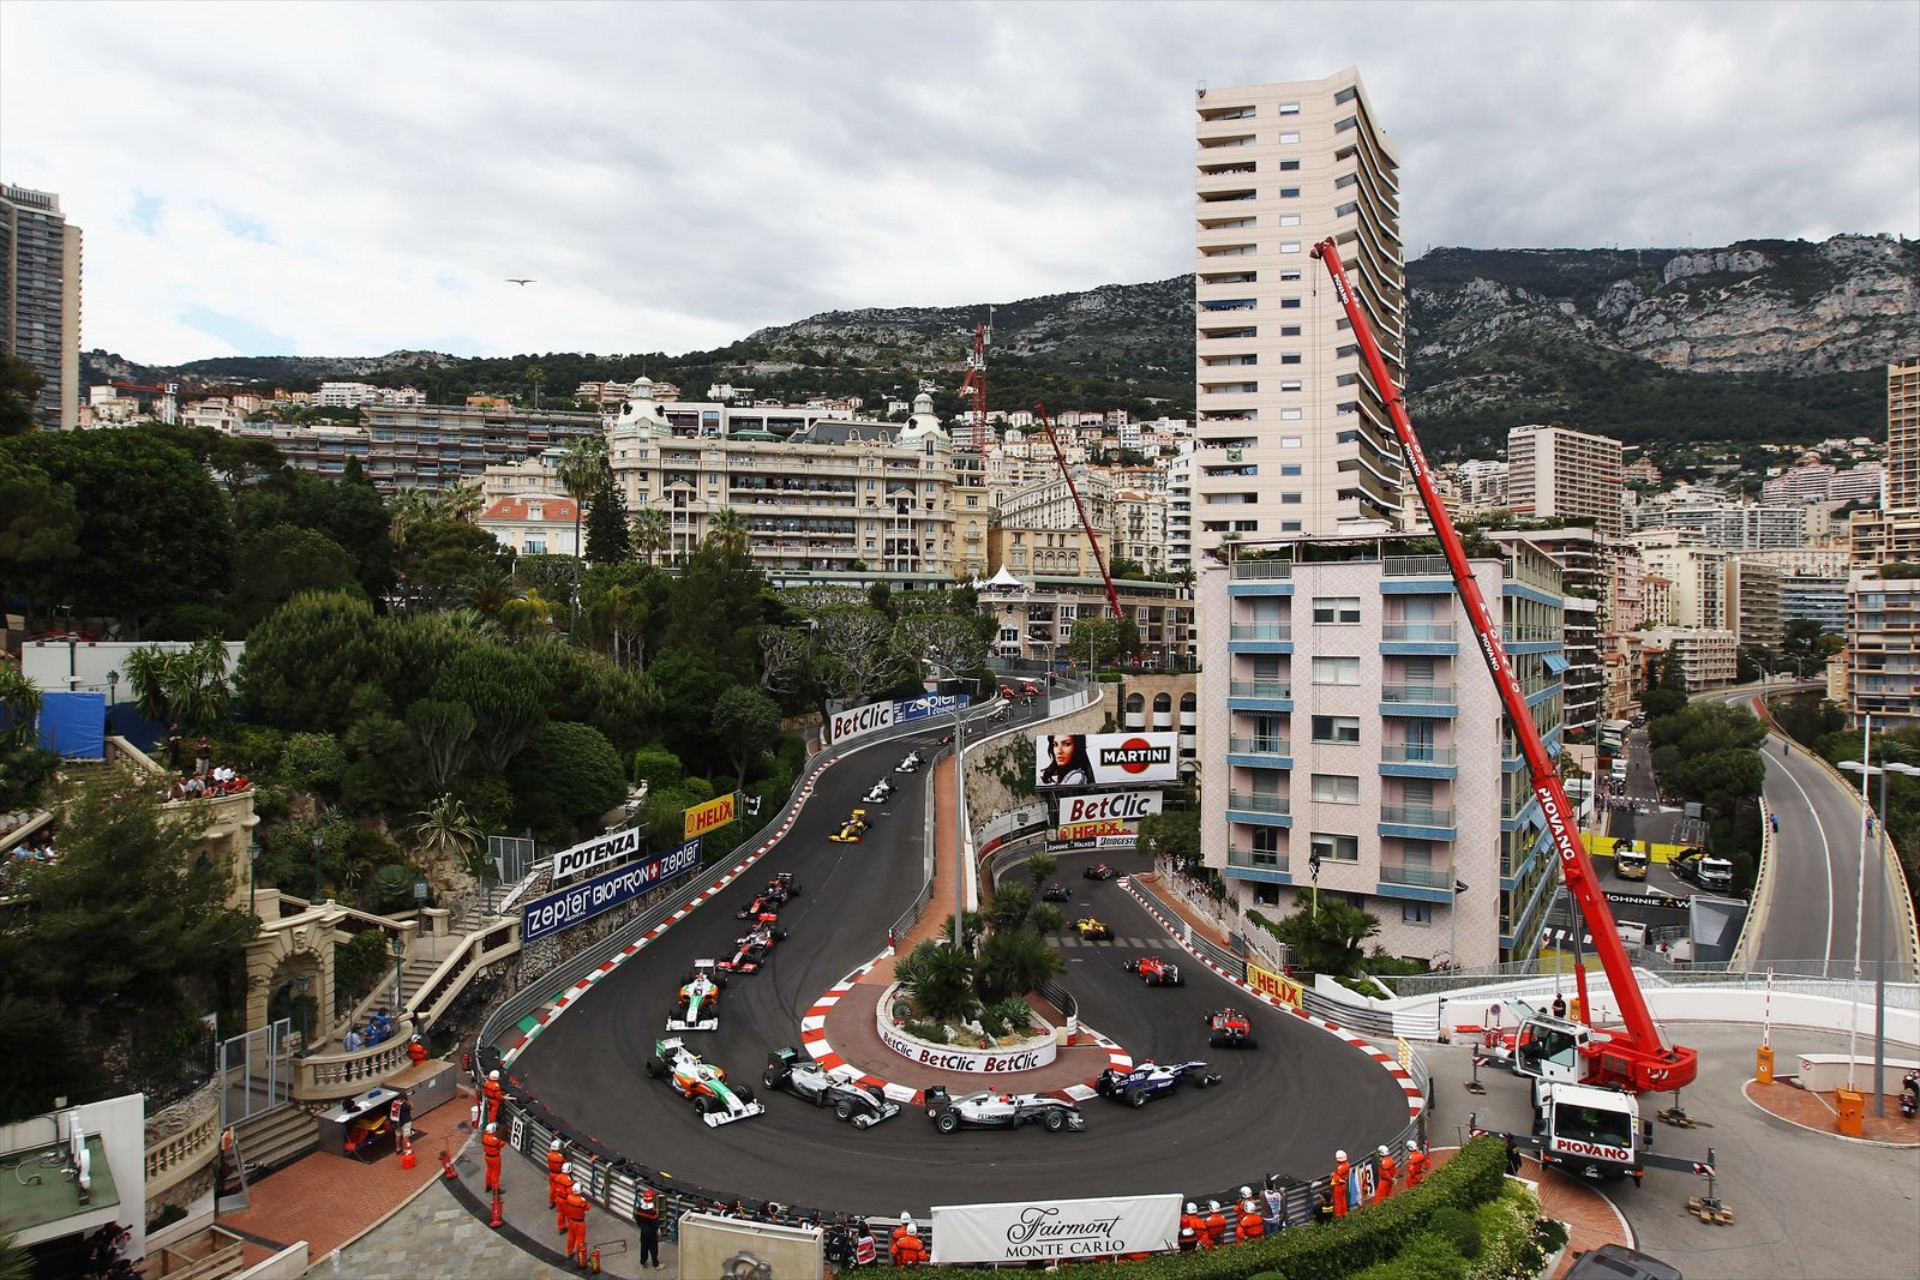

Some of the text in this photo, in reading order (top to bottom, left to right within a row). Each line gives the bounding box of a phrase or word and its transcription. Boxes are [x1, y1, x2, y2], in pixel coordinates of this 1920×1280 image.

[1481, 632, 1500, 671] PIOVANO
[834, 703, 889, 740] BetClic
[1103, 749, 1167, 763] MARTINI
[696, 800, 732, 831] HELIX
[1070, 793, 1151, 822] BetClic
[1538, 787, 1575, 860] PIOVANO
[559, 833, 635, 874] POTENZA
[593, 865, 650, 906] BIOPTRON
[1257, 972, 1298, 1006] HELIX
[883, 1031, 913, 1058] BetClic
[919, 1049, 975, 1071] BetClic
[984, 1052, 1039, 1072] BetClic
[1557, 1139, 1629, 1161] PIOVANO
[1007, 1207, 1121, 1245] Fairmont
[1005, 1239, 1125, 1258] MONTE CARLO
